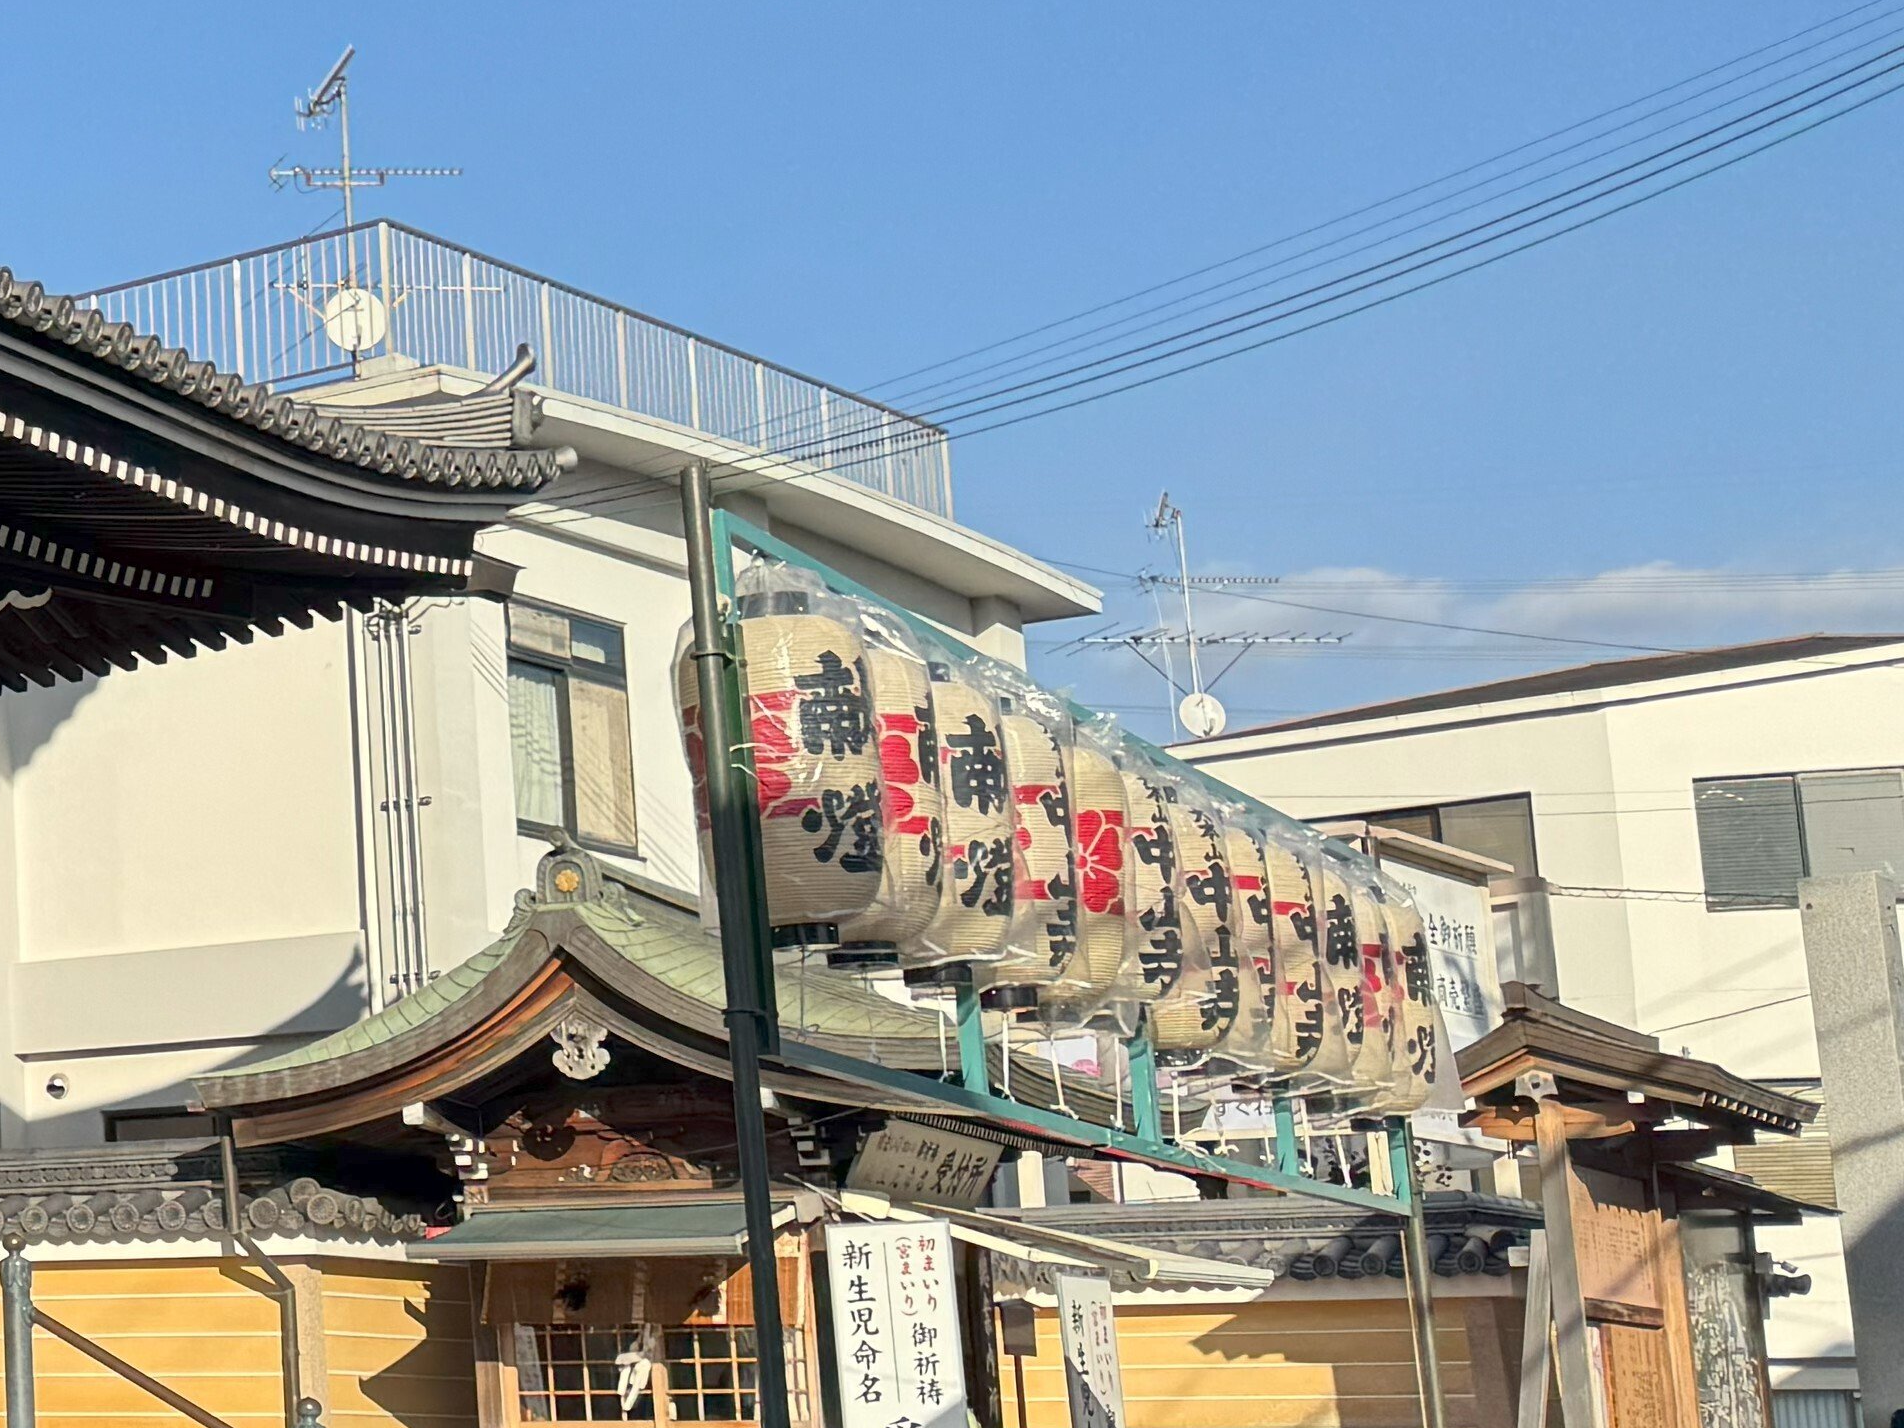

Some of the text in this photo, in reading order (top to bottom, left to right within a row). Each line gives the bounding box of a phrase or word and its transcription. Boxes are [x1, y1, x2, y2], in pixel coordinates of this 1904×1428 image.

[1185, 861, 1240, 1035] 中山寺
[842, 1240, 883, 1404] 新生児命名
[917, 1235, 940, 1312] 初まいり
[911, 1322, 944, 1406] 御祈祷
